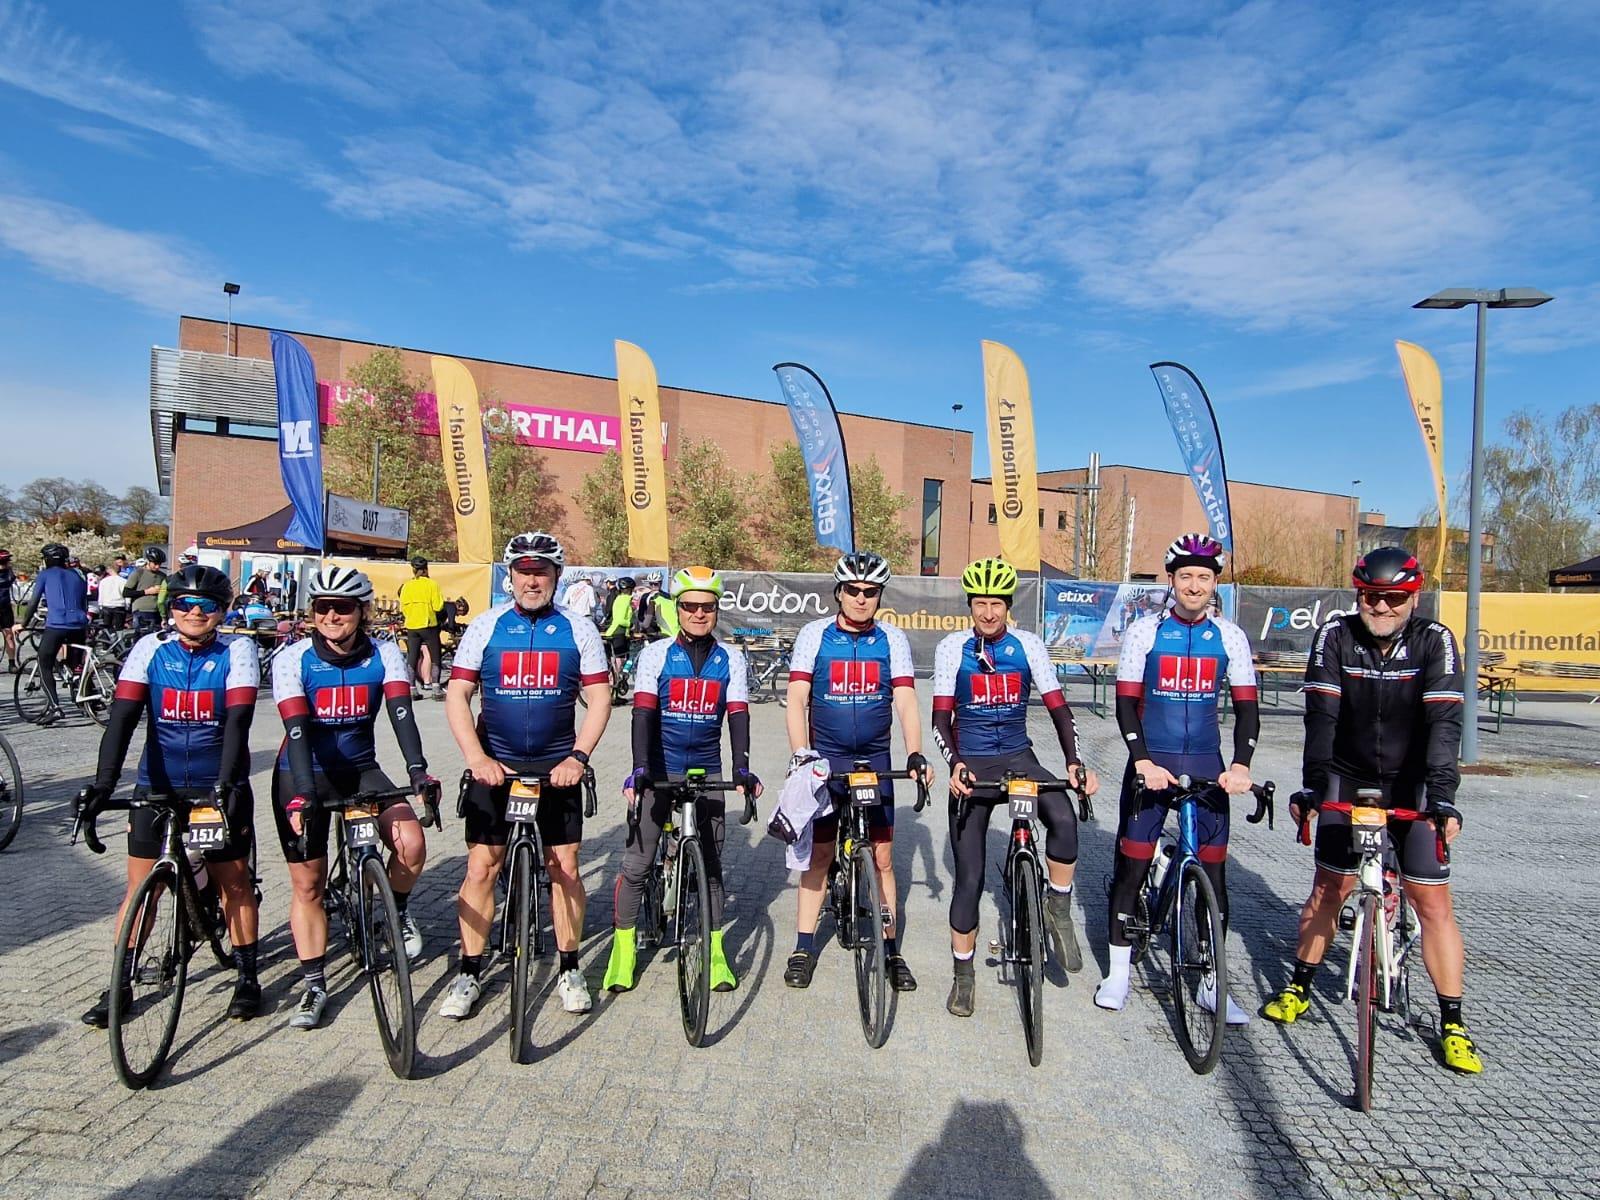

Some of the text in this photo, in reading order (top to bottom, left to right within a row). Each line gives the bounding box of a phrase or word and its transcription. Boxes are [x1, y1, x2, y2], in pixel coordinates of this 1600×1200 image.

[480, 407, 617, 446] ORTHAL
[362, 509, 379, 531] OUT
[718, 583, 829, 614] eloton
[1057, 589, 1094, 603] etixx
[873, 607, 975, 631] Continen
[1476, 629, 1600, 651] ontinental
[1152, 688, 1180, 697] Samen
[508, 801, 536, 815] 1184
[1013, 800, 1032, 813] 770
[190, 828, 223, 843] 1514
[1358, 830, 1382, 845] 754
